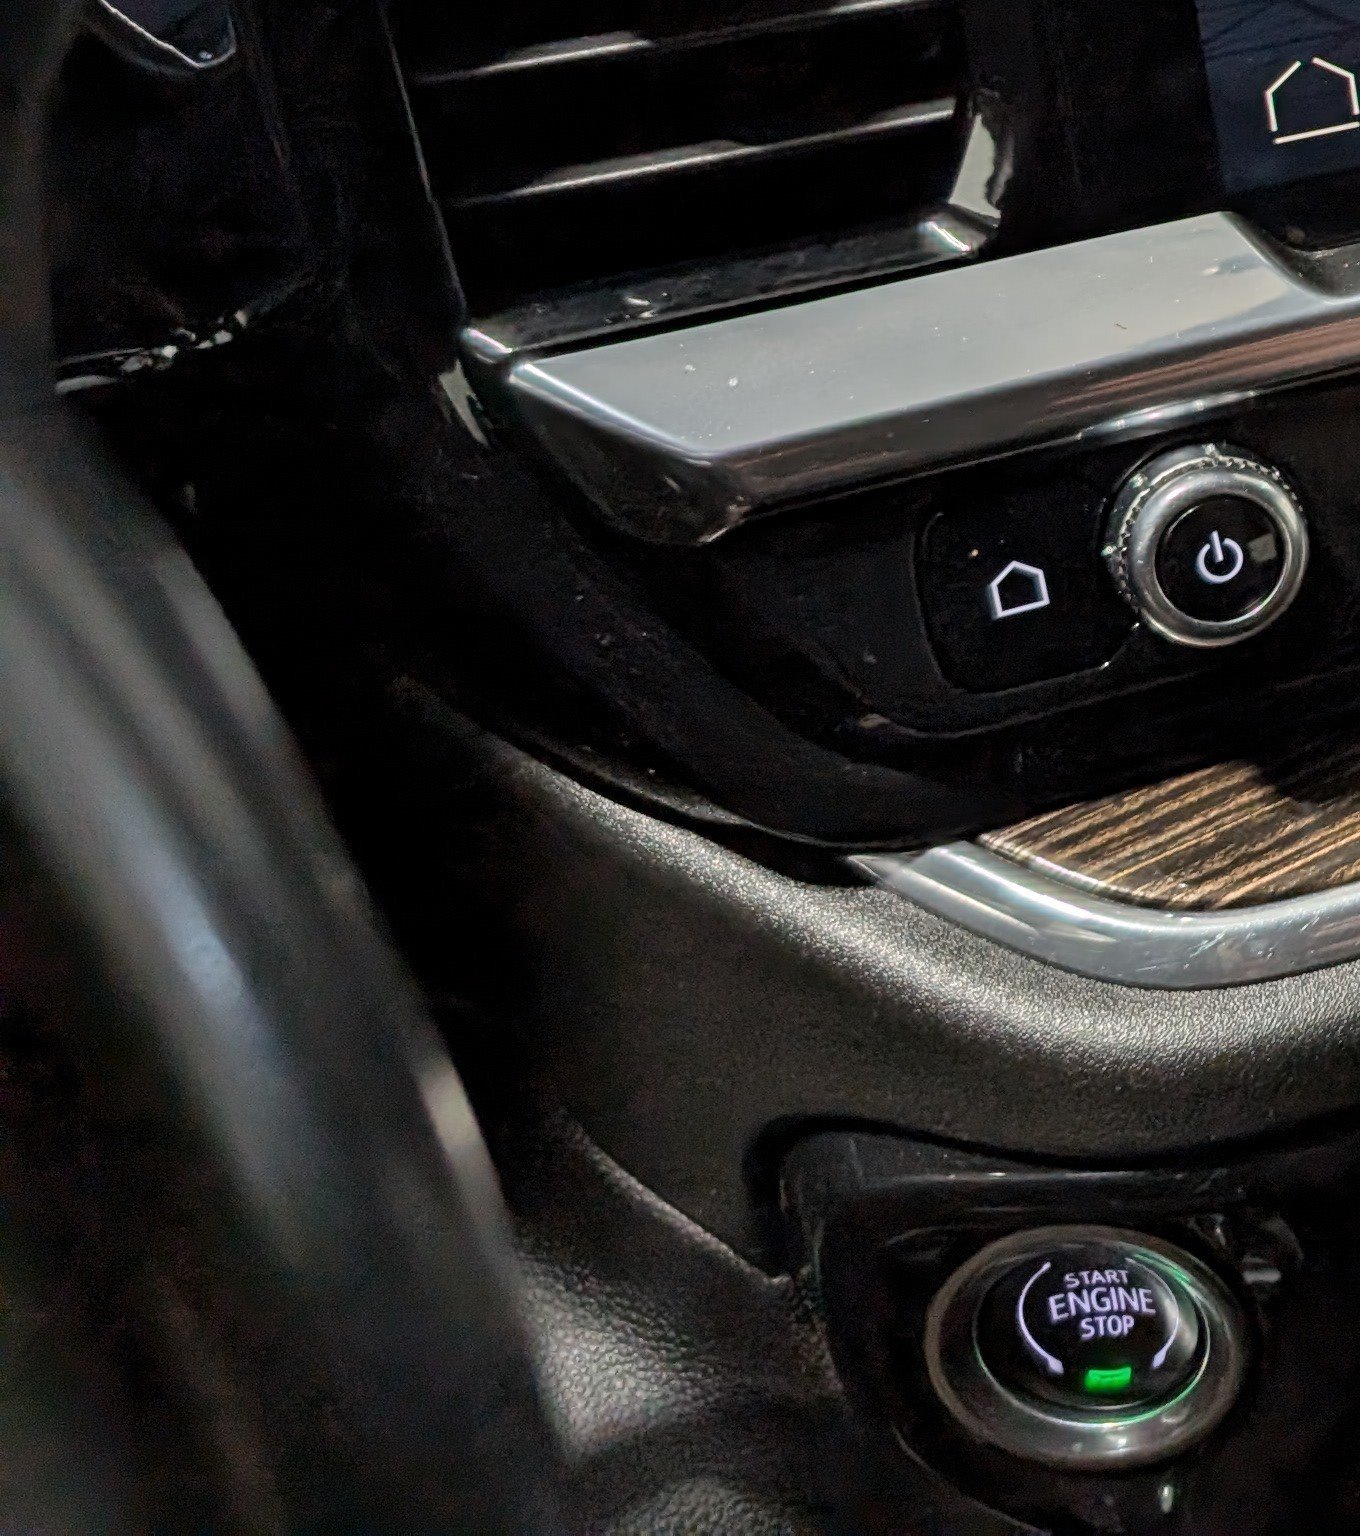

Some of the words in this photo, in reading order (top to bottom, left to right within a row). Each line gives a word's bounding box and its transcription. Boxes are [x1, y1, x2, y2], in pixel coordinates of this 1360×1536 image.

[1063, 1268, 1129, 1289] START
[1048, 1286, 1156, 1325] ENGINE
[1080, 1314, 1135, 1341] STOP
